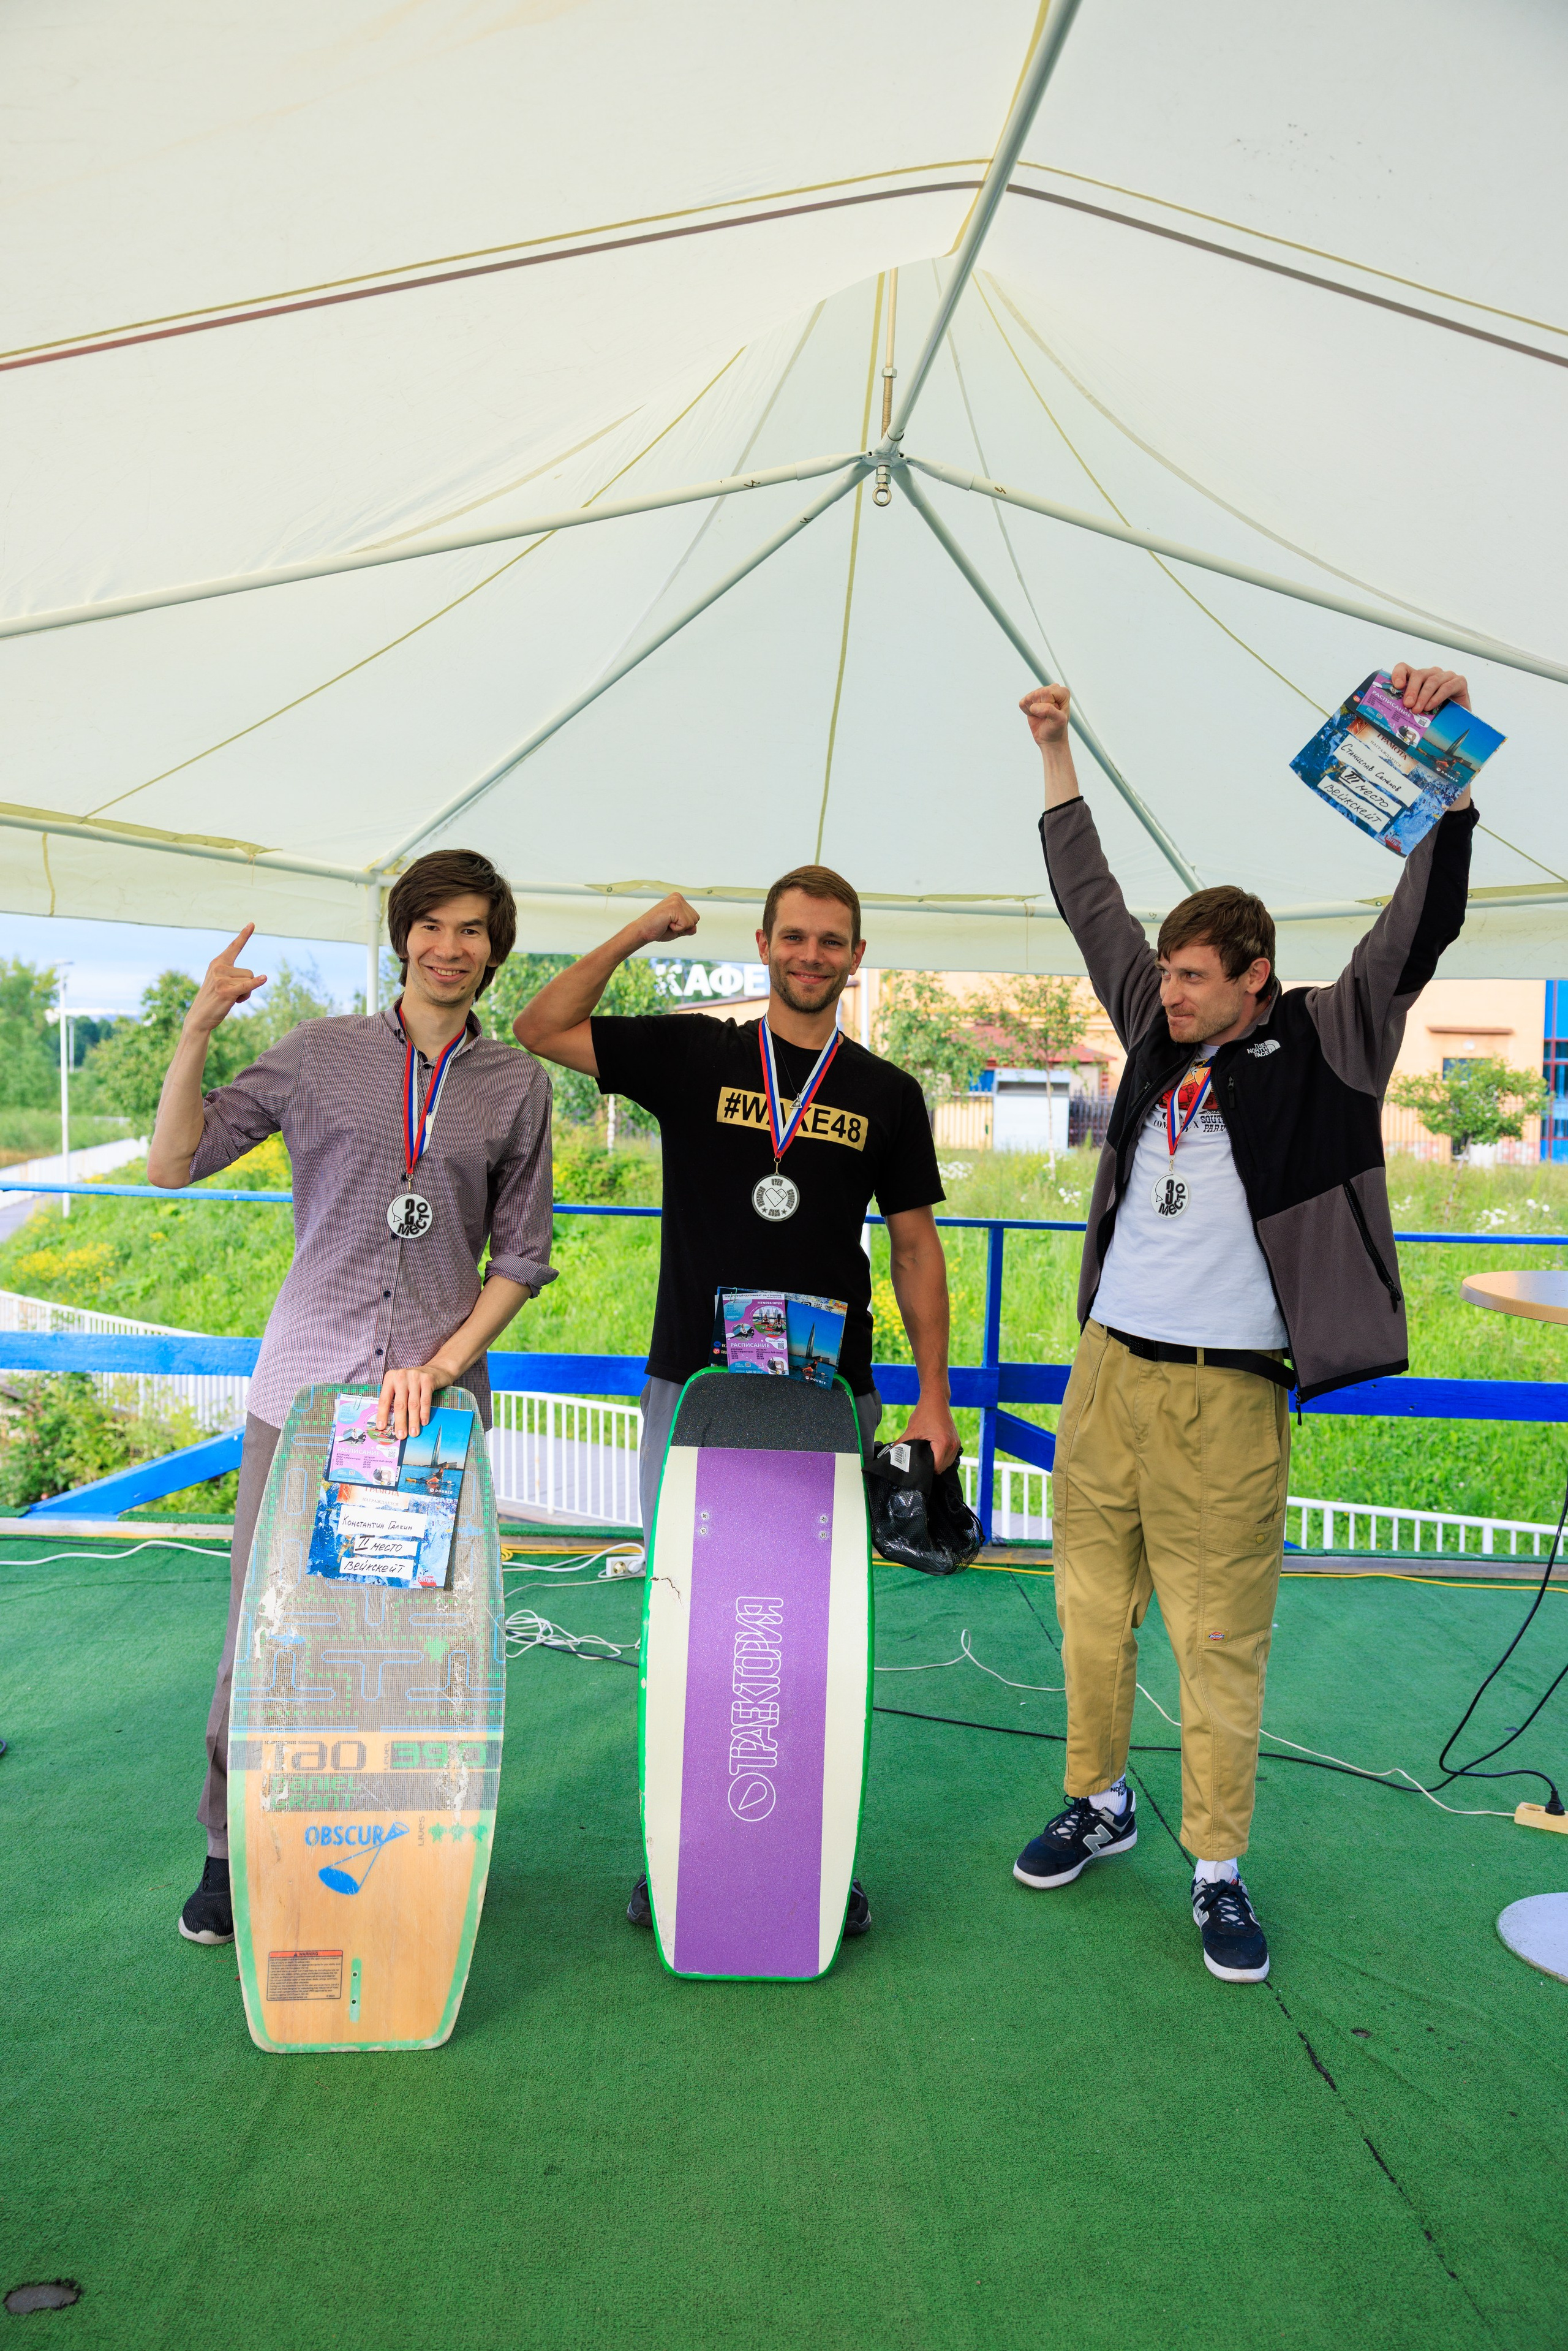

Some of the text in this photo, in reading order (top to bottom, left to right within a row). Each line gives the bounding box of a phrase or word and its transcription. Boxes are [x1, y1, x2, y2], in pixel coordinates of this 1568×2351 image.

[1373, 690, 1411, 717] РАСПИСАНИЕ
[1370, 740, 1401, 768] НАГРАЖДАЕТСЯ
[1377, 733, 1408, 760] ГРАМОТА
[1441, 771, 1458, 782] DOUBLE
[655, 964, 766, 996] КАФЕ
[785, 1189, 795, 1209] CONTEST
[1166, 1179, 1174, 1205] 3
[405, 1198, 415, 1225] 2
[337, 1447, 380, 1456] РАСПИСАНИЕ
[362, 1498, 399, 1507] НАГРАЖДАЕТСЯ
[342, 1515, 413, 1531] Константин Галкин
[729, 1596, 783, 1775] ТРАЕКТОРИЯ
[392, 1743, 486, 1767] 390
